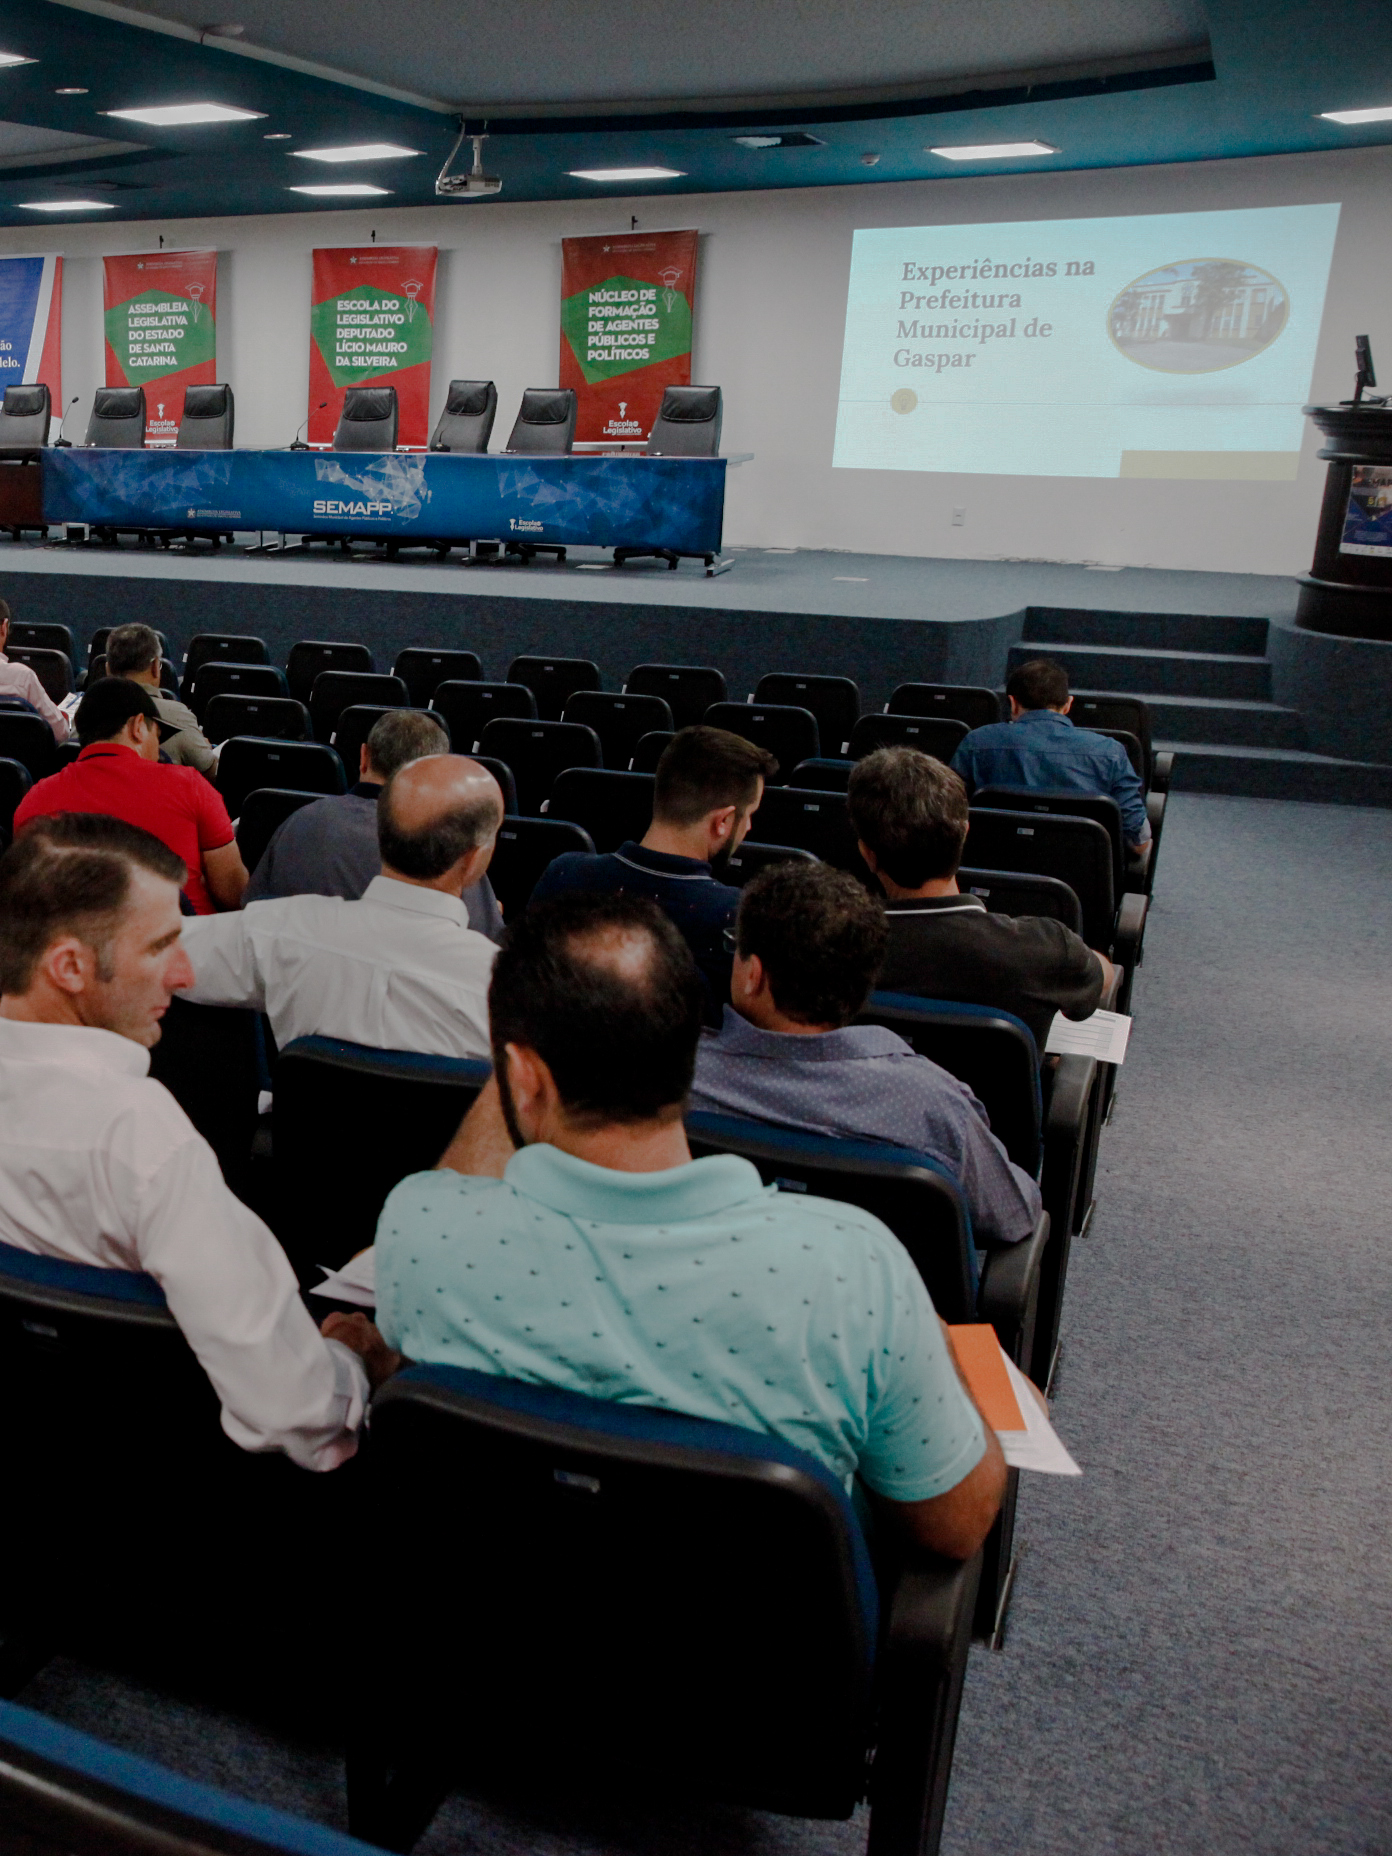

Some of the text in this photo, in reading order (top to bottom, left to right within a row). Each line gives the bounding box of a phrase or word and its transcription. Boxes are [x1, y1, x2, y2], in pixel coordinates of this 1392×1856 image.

[901, 257, 1095, 286] Experiências na
[588, 289, 656, 303] NÚCLEO DE
[899, 289, 1022, 309] Prefeitura
[128, 302, 189, 314] ASSEMBLEIA
[337, 300, 399, 311] ESCOLA DO
[588, 302, 656, 319] FORMAÇÃO
[128, 315, 188, 327] LEGISLATIVA
[336, 314, 404, 325] LEGISLATIVO
[588, 319, 659, 332] DE AGENTES
[129, 329, 184, 340] DO ESTADO
[336, 328, 395, 338] DEPUTADO
[896, 317, 1053, 344] Municipal de
[588, 333, 655, 346] PÚBLICOS E
[129, 342, 176, 353] DE SANTA
[336, 340, 407, 352] LÍCIO MAURO
[587, 347, 649, 361] POLÍTICOS
[129, 356, 178, 366] CATARINA
[336, 356, 397, 366] DA SILVEIRA
[893, 349, 976, 373] Gaspar
[603, 427, 642, 436] Legislativo
